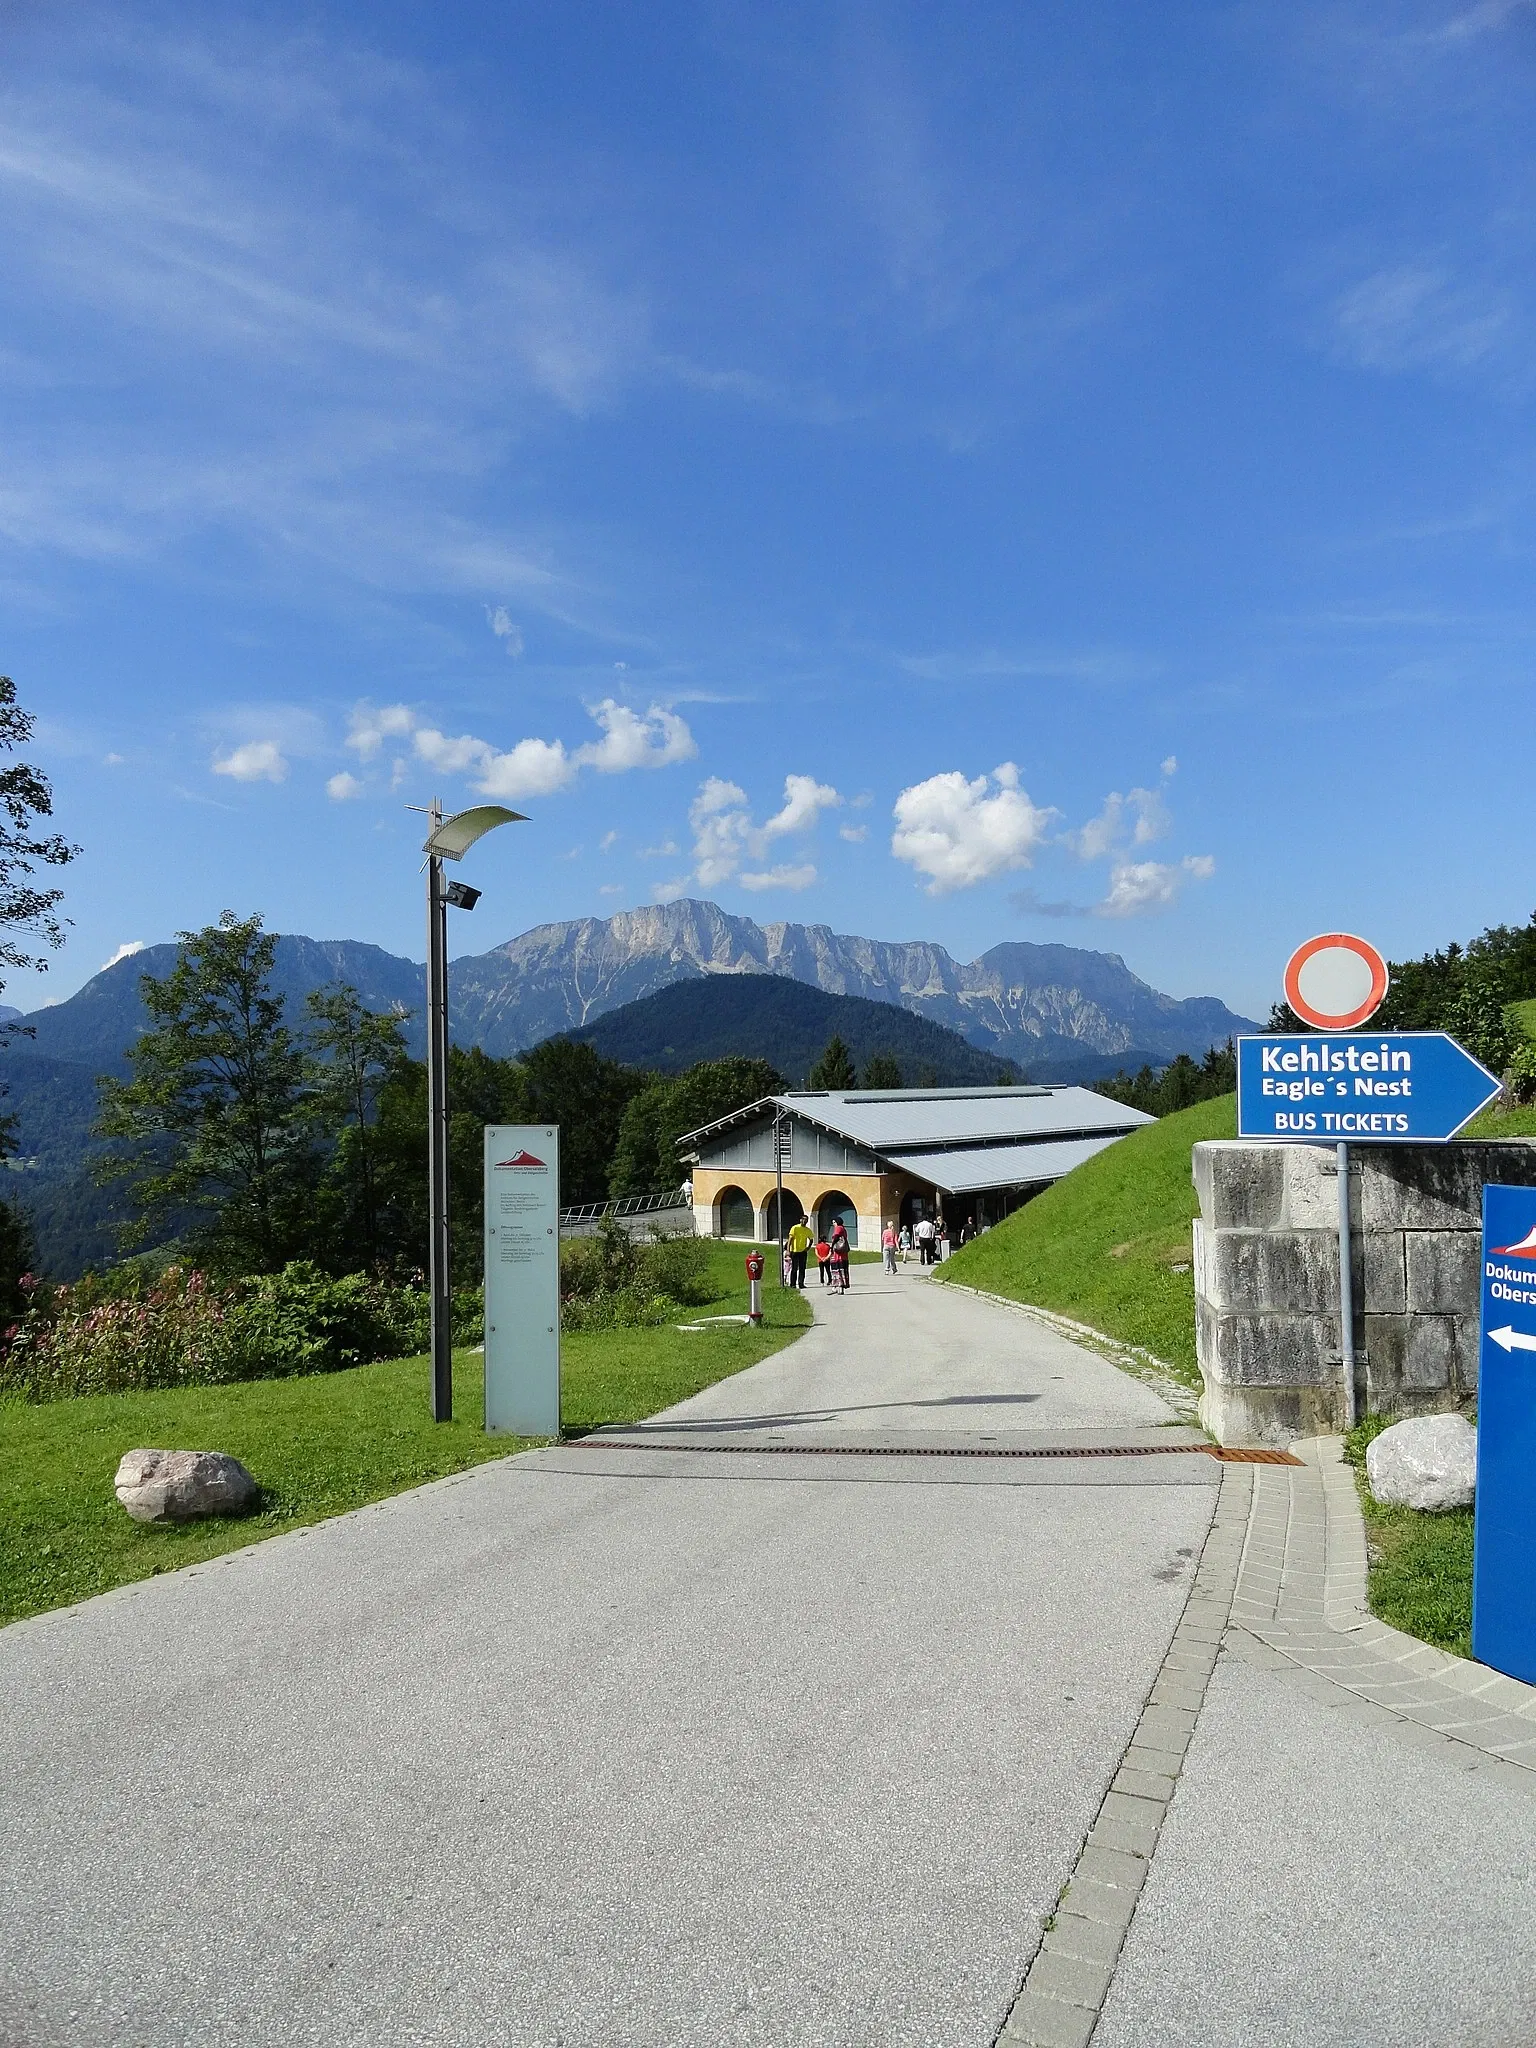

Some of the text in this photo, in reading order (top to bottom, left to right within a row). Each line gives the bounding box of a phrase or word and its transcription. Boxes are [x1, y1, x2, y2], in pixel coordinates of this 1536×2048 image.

[1262, 1043, 1411, 1072] Kehlstein
[1354, 1077, 1412, 1096] Nest
[1275, 1112, 1409, 1132] BUS TICKETS
